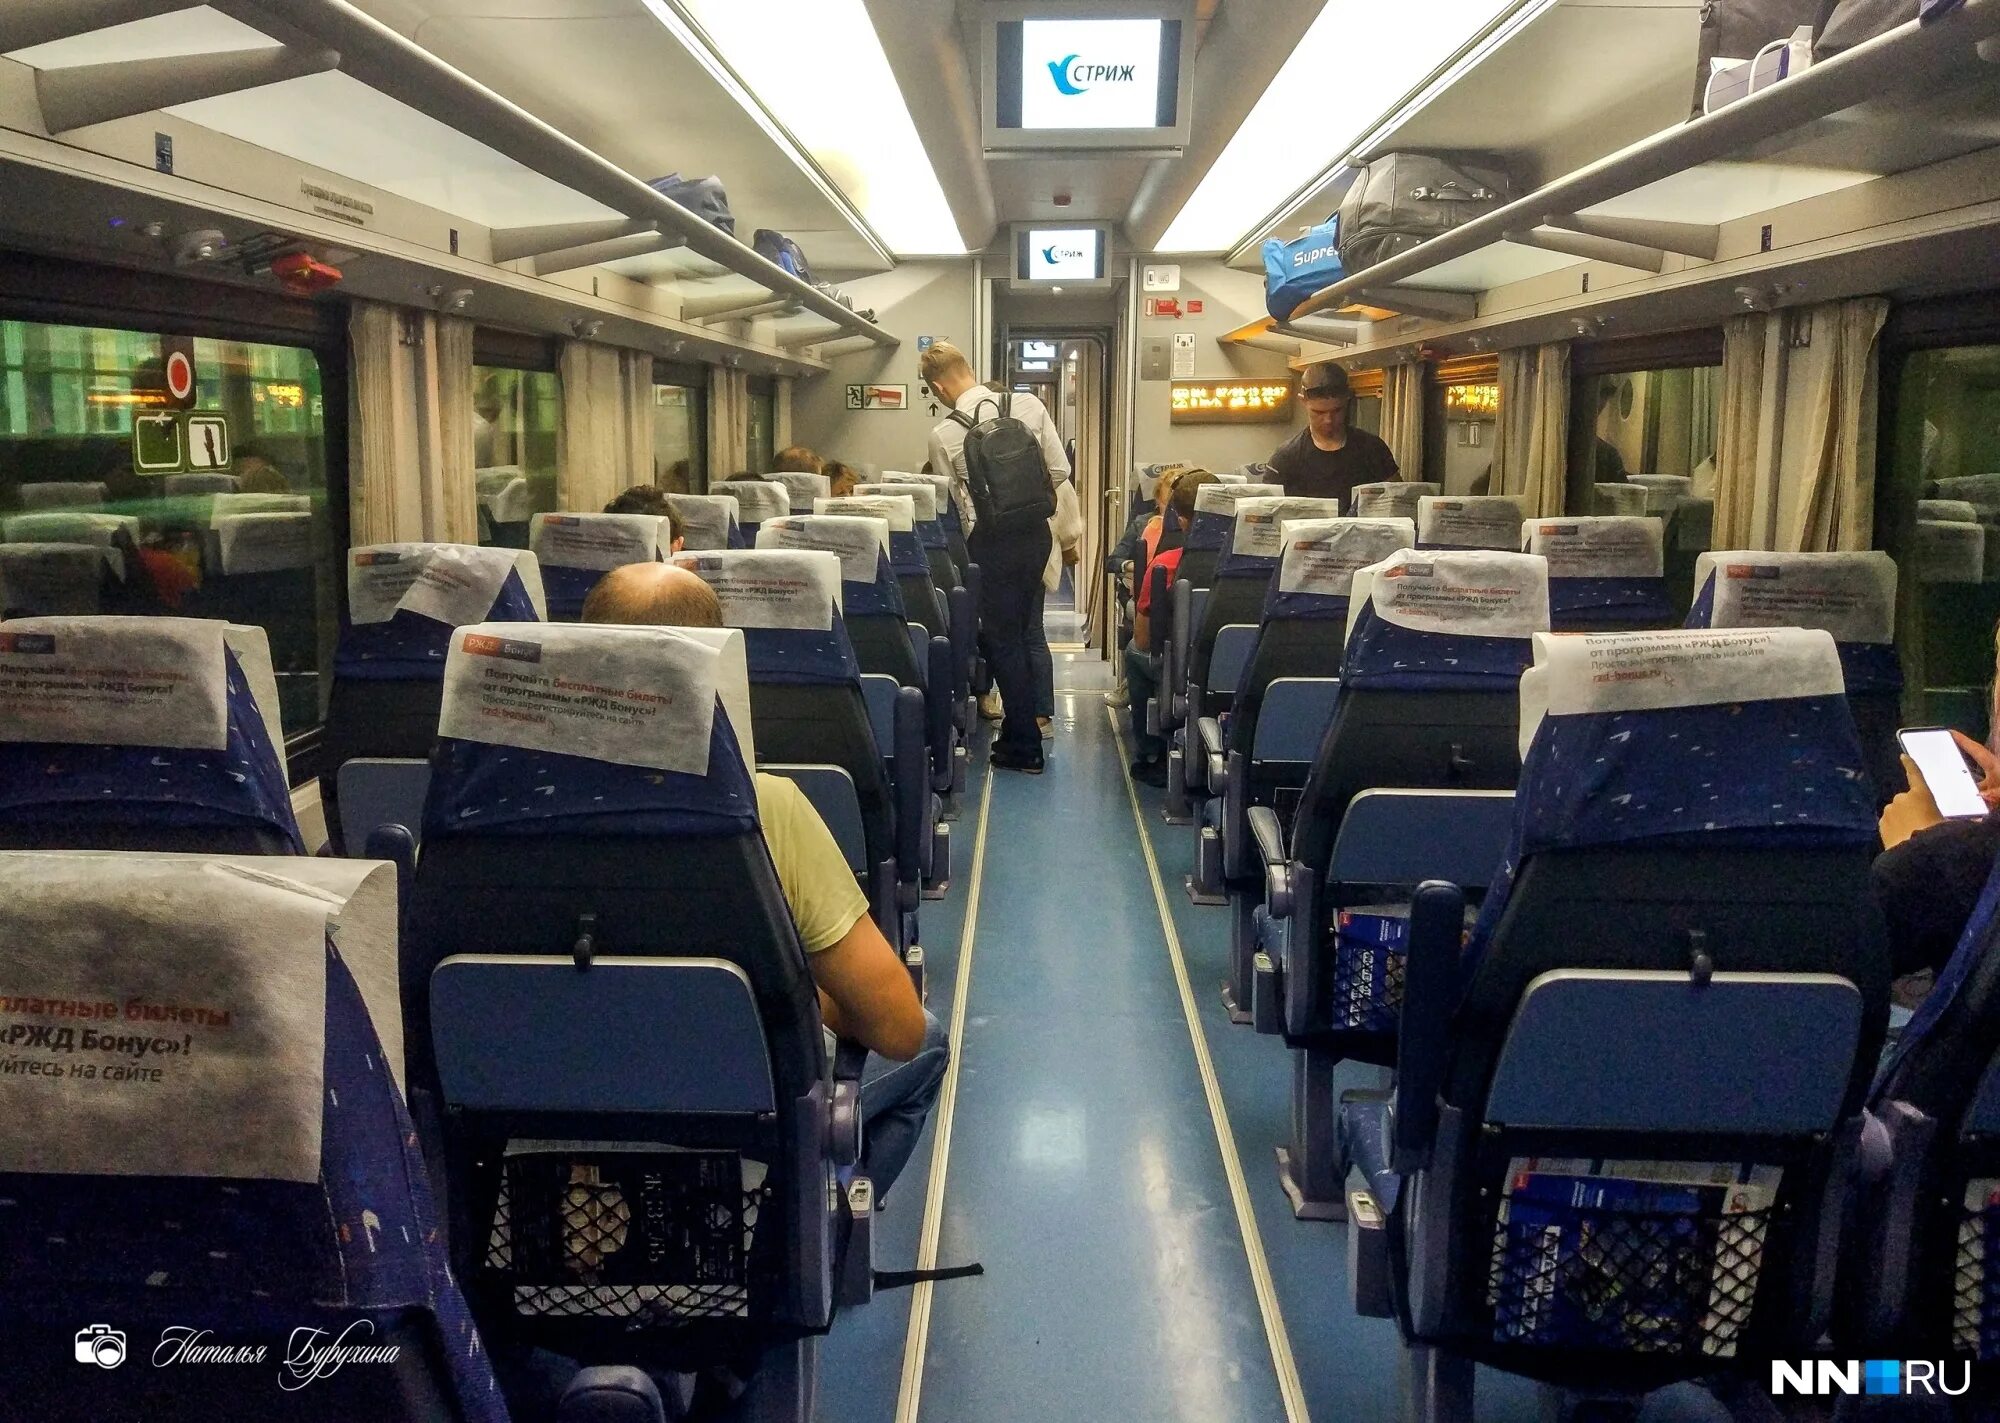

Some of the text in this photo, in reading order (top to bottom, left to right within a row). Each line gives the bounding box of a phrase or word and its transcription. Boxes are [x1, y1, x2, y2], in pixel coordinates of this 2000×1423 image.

[1073, 65, 1135, 81] СТРИЖ
[1590, 635, 1771, 658] от программы «РЖД Бонус»!
[1591, 658, 1626, 671] Просто
[485, 668, 673, 705] Получайте бесплатные билеты
[484, 683, 497, 692] от
[499, 685, 571, 704] программы
[609, 701, 656, 717] Бонус»!
[124, 999, 230, 1026] билеты
[81, 1029, 192, 1058] Бонус»!
[70, 1064, 97, 1080] на
[102, 1061, 162, 1082] сайте
